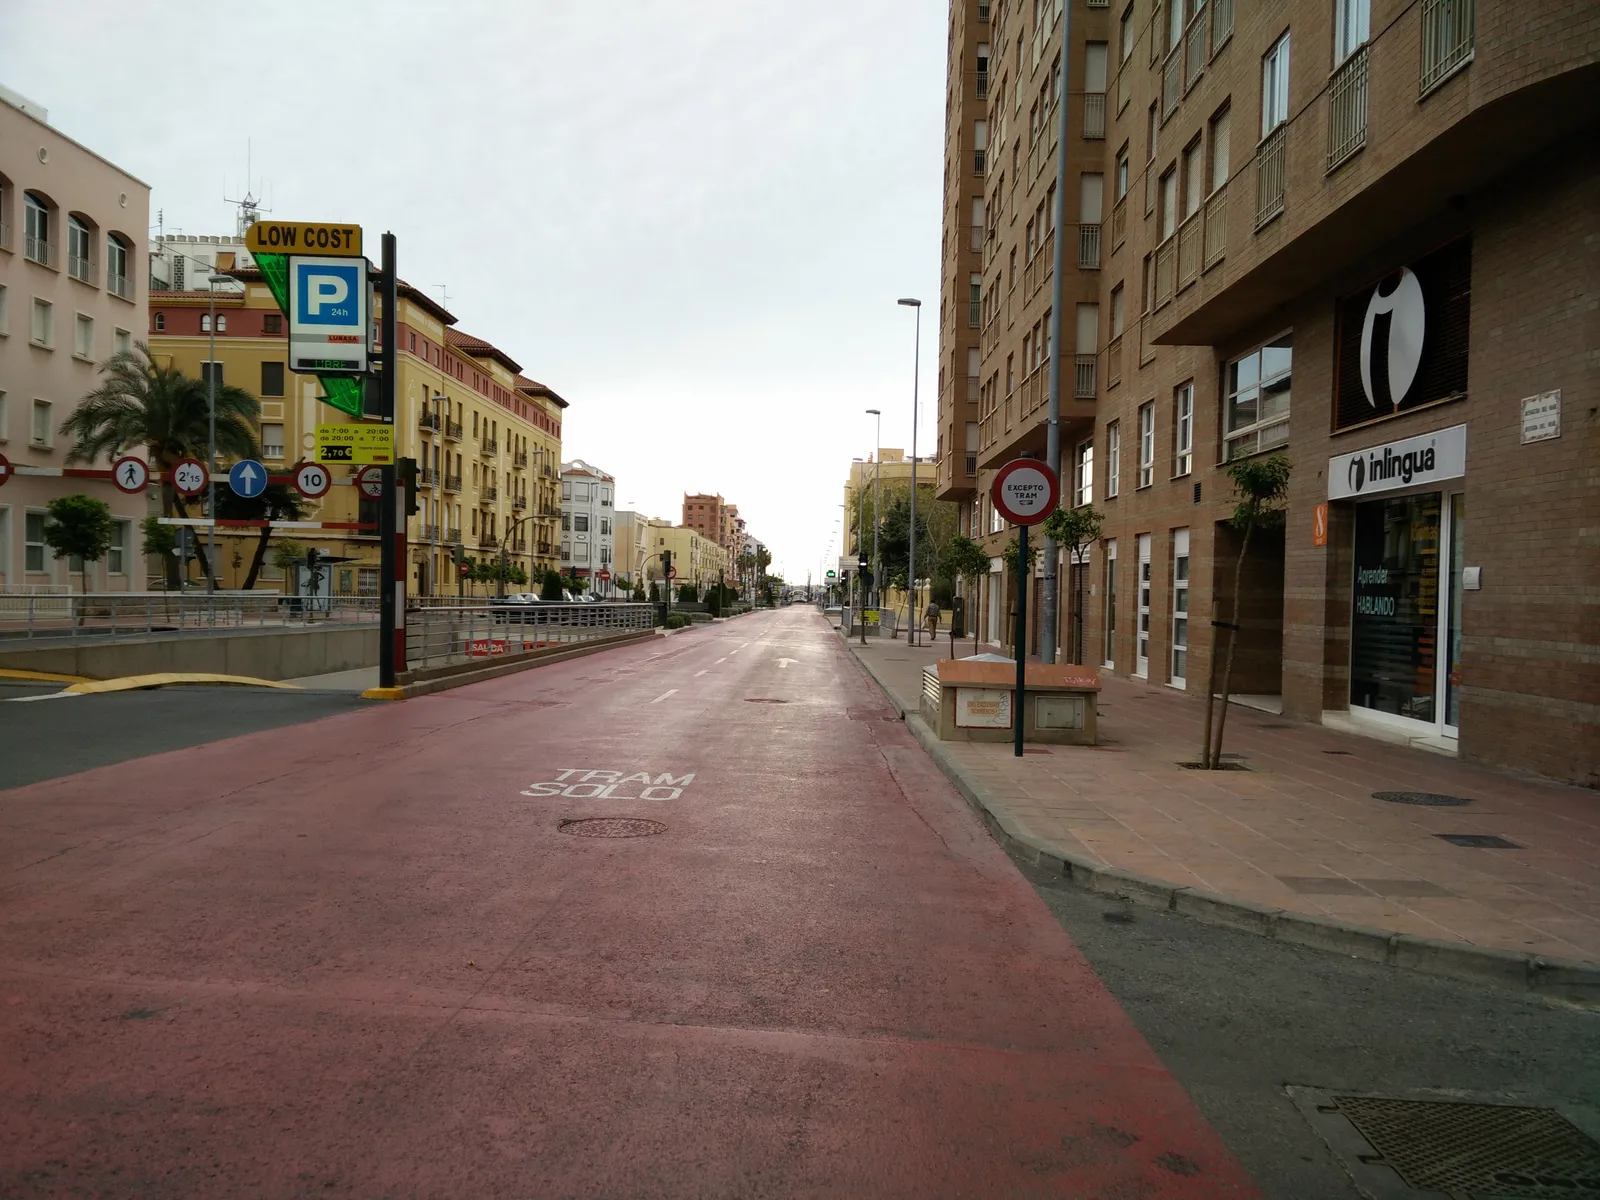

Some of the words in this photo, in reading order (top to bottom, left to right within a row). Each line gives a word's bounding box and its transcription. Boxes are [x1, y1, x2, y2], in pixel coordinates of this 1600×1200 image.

[257, 225, 297, 247] LOW
[303, 227, 354, 249] COST
[307, 275, 349, 315] P
[331, 308, 349, 316] 24h
[1370, 447, 1435, 484] inlingua
[303, 474, 322, 487] 10
[1358, 565, 1388, 588] Aprender
[1357, 596, 1395, 616] HABLANDO
[472, 643, 504, 653] SALDA
[555, 768, 696, 786] TRAM
[520, 782, 684, 801] SOLO
